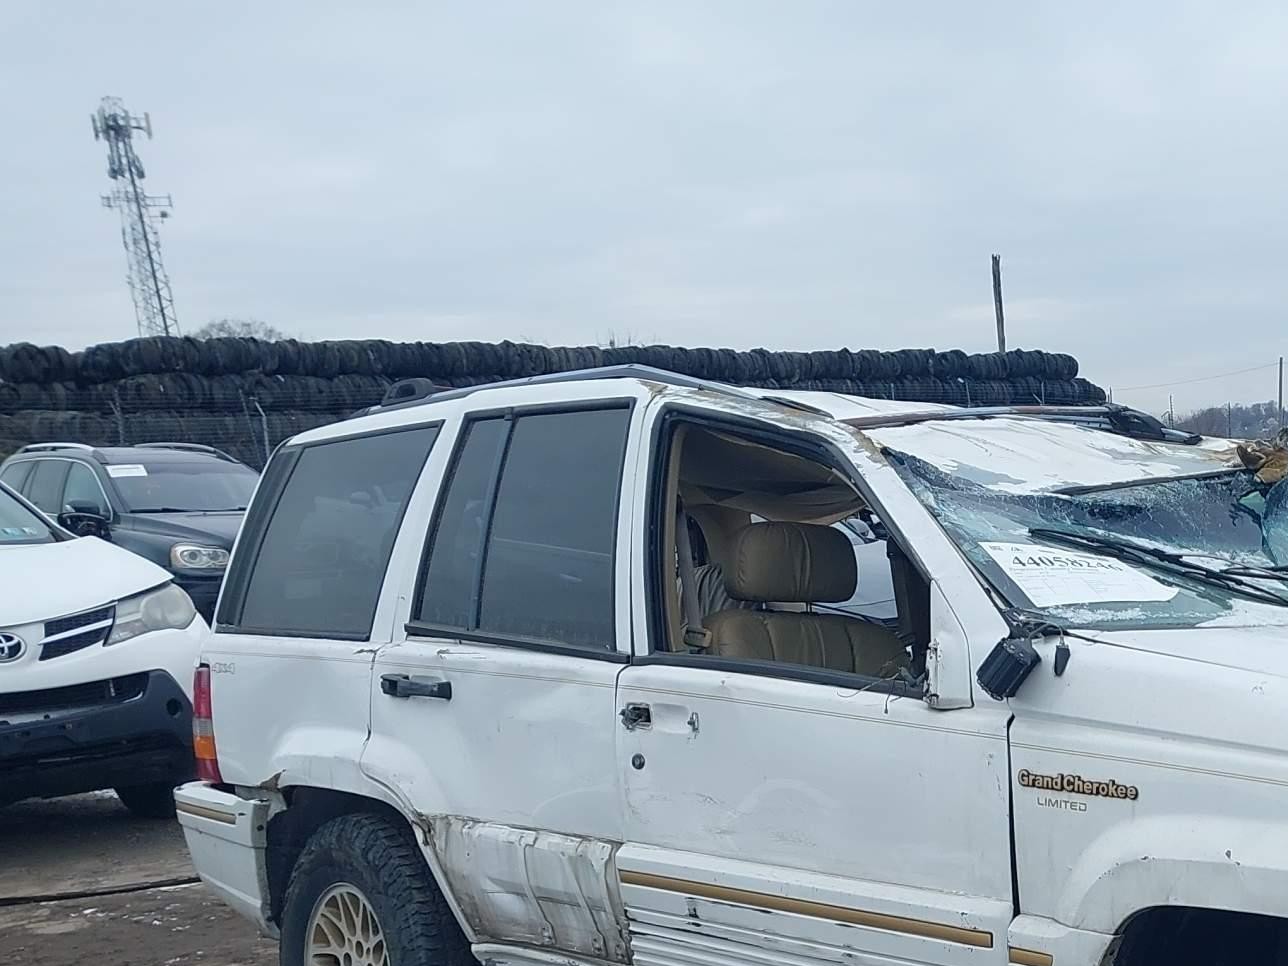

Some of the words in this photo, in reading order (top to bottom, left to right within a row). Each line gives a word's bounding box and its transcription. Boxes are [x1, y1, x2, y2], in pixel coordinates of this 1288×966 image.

[1018, 769, 1064, 791] Grand
[1063, 775, 1139, 800] Cherokee
[1037, 797, 1088, 812] LIMITED
